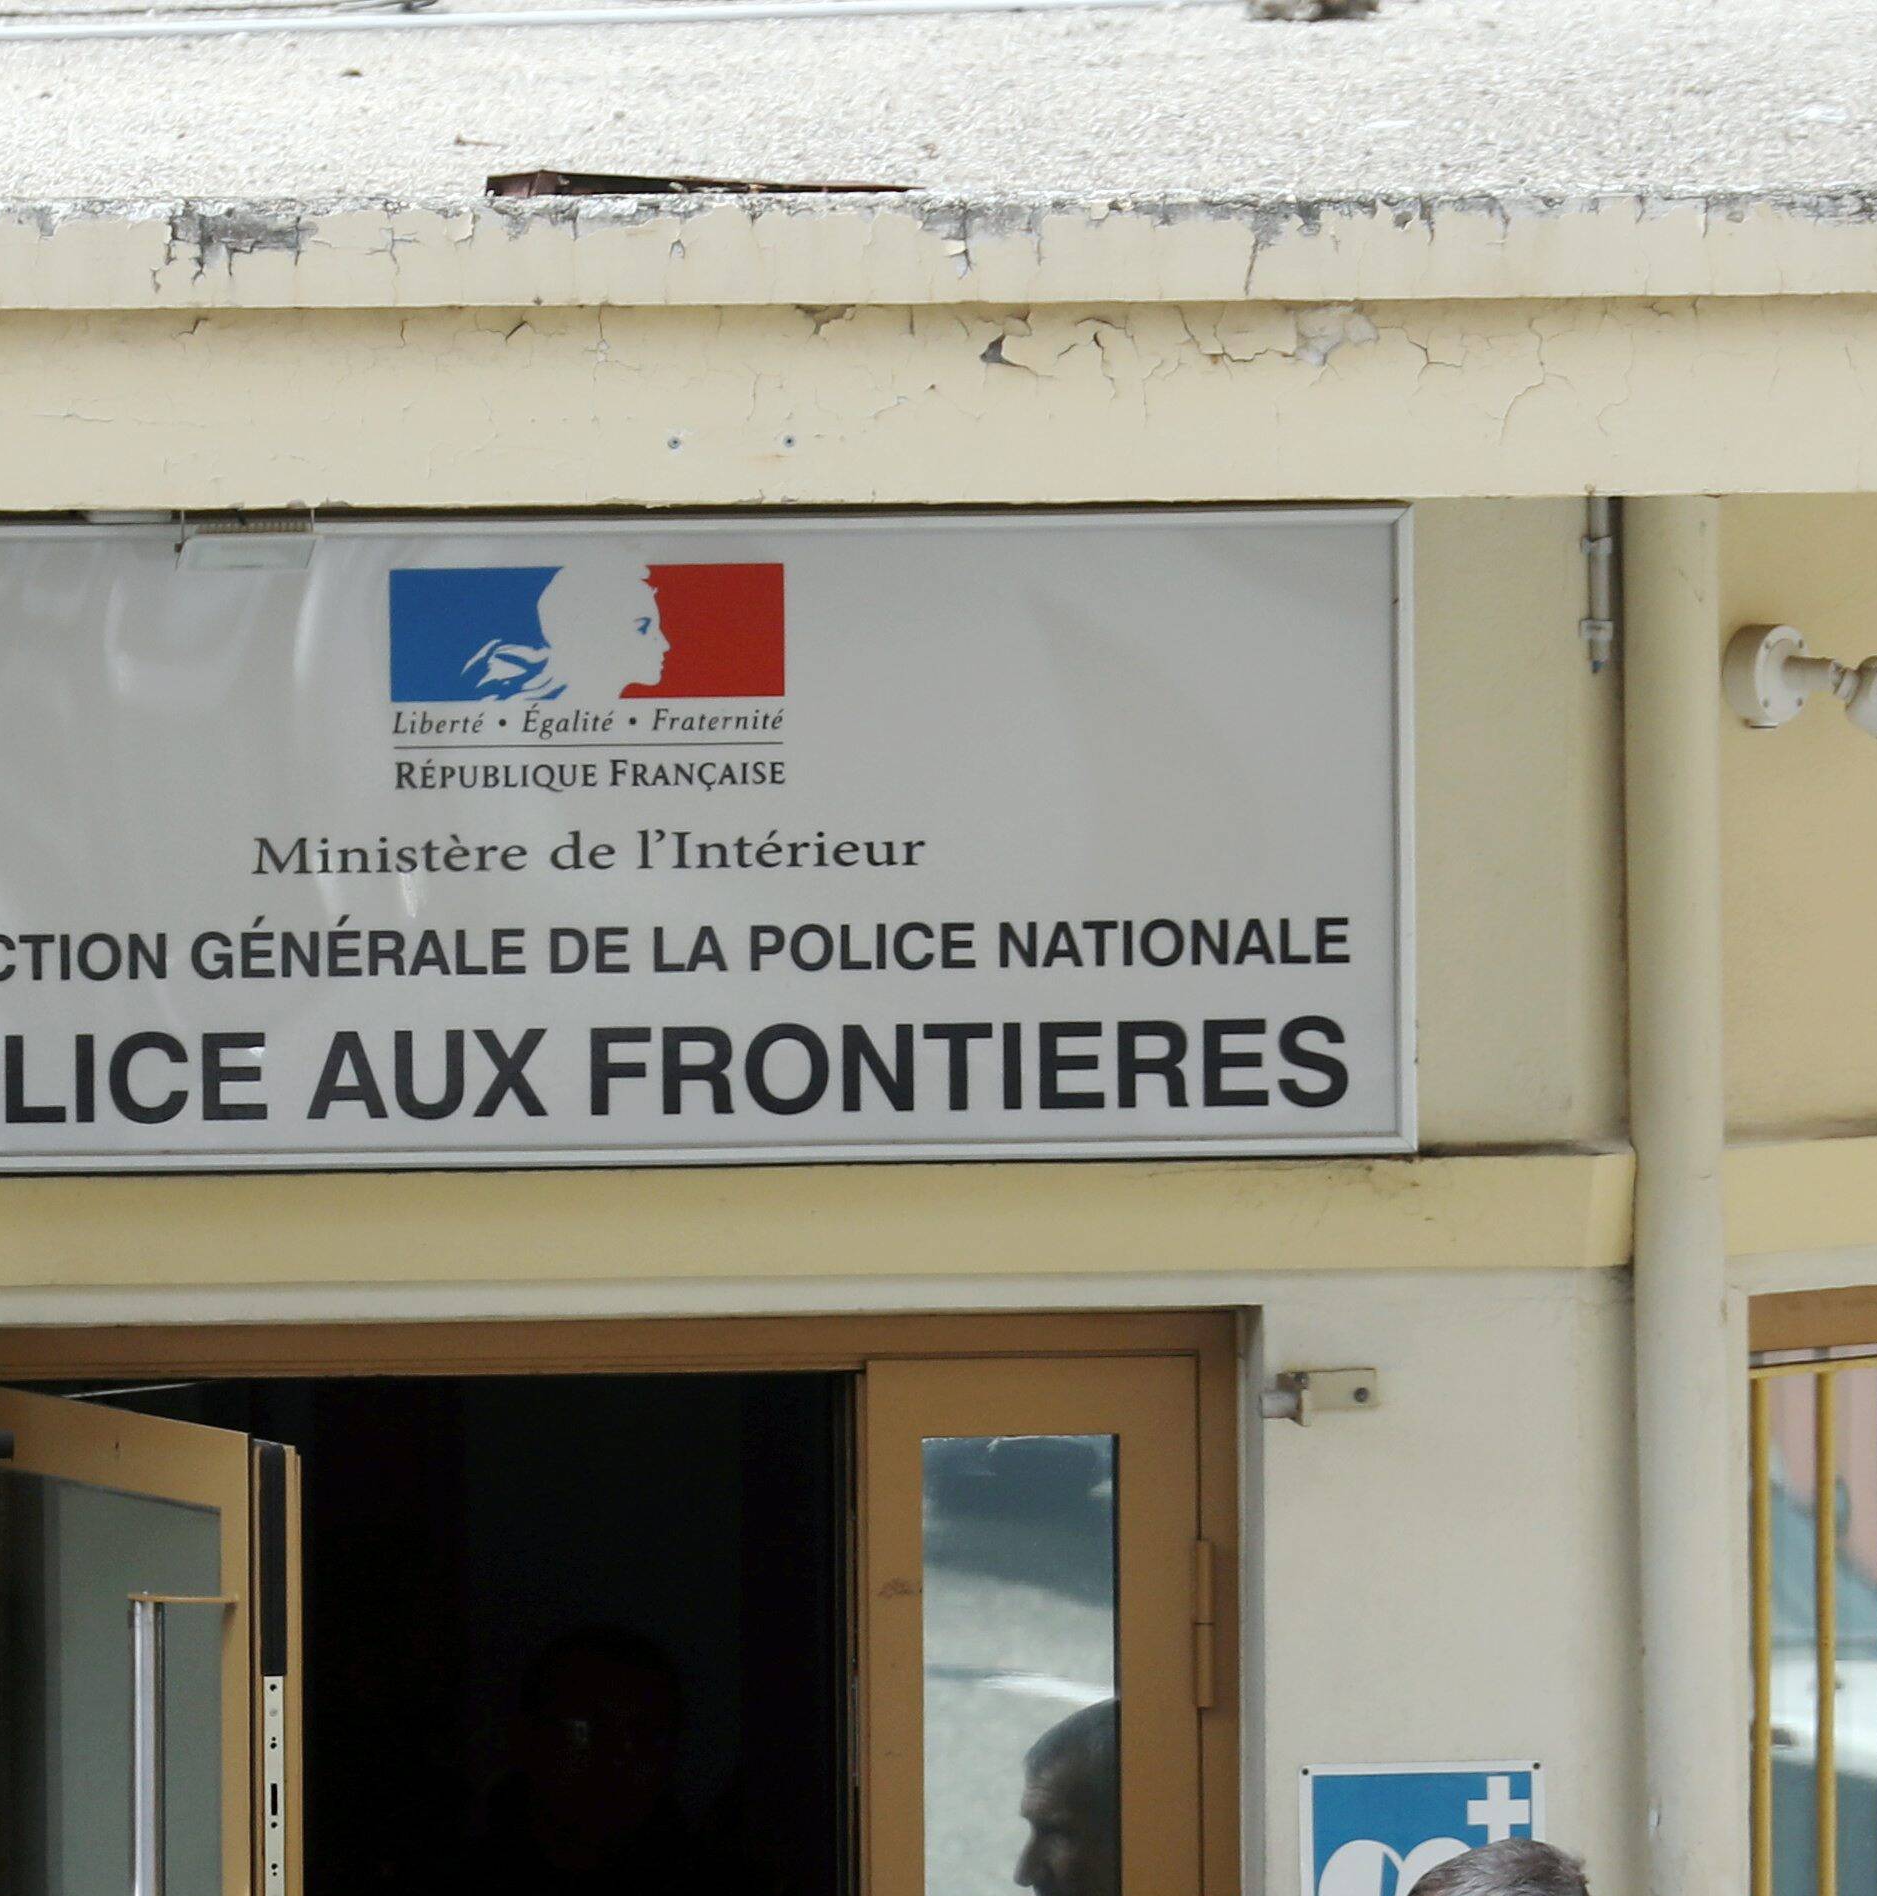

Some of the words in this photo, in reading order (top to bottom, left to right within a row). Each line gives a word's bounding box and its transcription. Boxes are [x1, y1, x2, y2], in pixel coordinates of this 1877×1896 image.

[393, 711, 483, 734] Liberté
[523, 703, 613, 739] Égalité
[653, 709, 782, 730] Fraternité
[396, 759, 597, 792] RÉPUBLIQUE
[610, 760, 785, 791] FRANÇAISE
[252, 834, 527, 874] Ministère
[550, 831, 615, 870] de
[638, 829, 925, 868] l'Intérieur
[191, 915, 526, 980] GÉNÉRALE
[550, 927, 630, 973] DE
[654, 926, 728, 972] LA
[751, 922, 976, 971] POLICE
[1000, 917, 1350, 968] NATIONALE
[307, 1028, 548, 1120] AUX
[591, 1016, 1348, 1115] FRONTIERES
